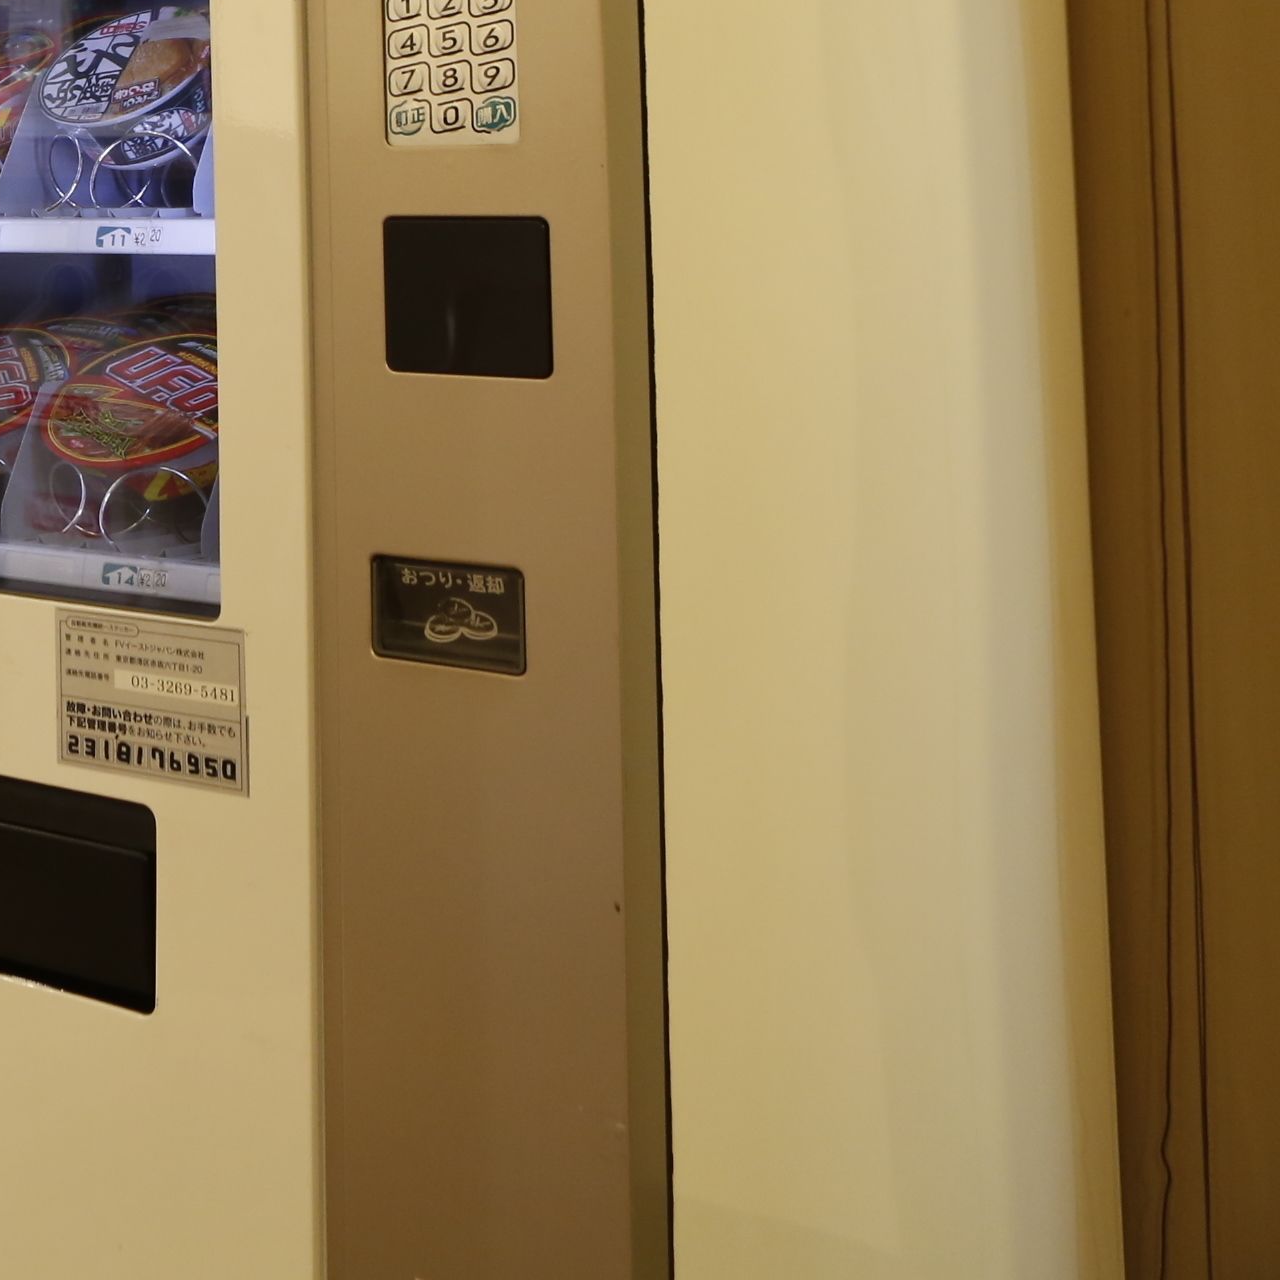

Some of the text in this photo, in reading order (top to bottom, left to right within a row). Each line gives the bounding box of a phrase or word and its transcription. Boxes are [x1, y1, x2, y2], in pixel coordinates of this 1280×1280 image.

[400, 28, 499, 51] 4 5 6
[401, 66, 500, 90] 7 8 9
[396, 105, 426, 128] 訂正
[443, 105, 460, 126] 0
[109, 235, 125, 246] 11
[115, 571, 135, 586] 14
[401, 568, 505, 595] おつり・返却
[131, 675, 236, 703] 03-3269-5481
